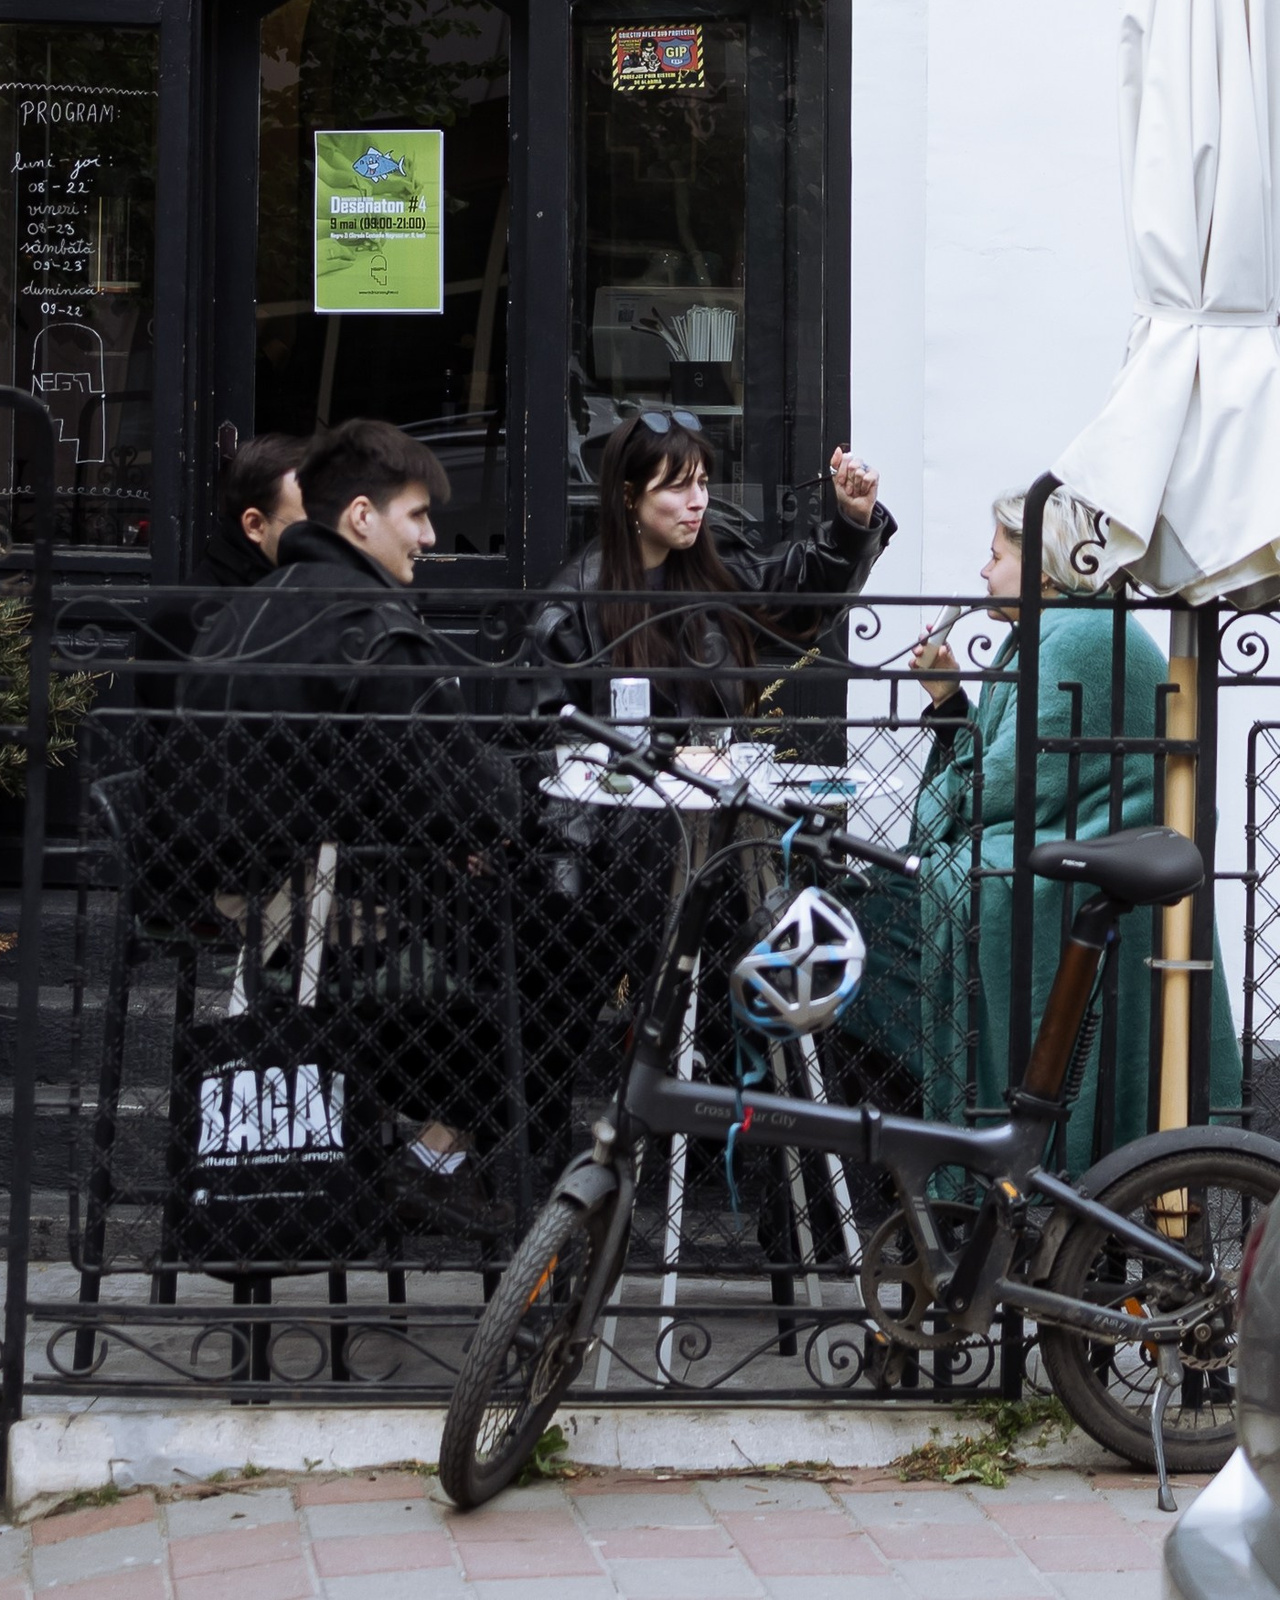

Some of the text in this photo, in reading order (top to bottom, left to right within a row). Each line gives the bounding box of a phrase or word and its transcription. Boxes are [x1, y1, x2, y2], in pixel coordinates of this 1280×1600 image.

[665, 45, 689, 58] GIP
[11, 152, 55, 173] luni
[330, 196, 404, 214] Desenaton
[330, 217, 337, 230] 9
[339, 218, 357, 230] mai
[695, 1102, 732, 1118] Cross
[771, 1112, 797, 1128] City
